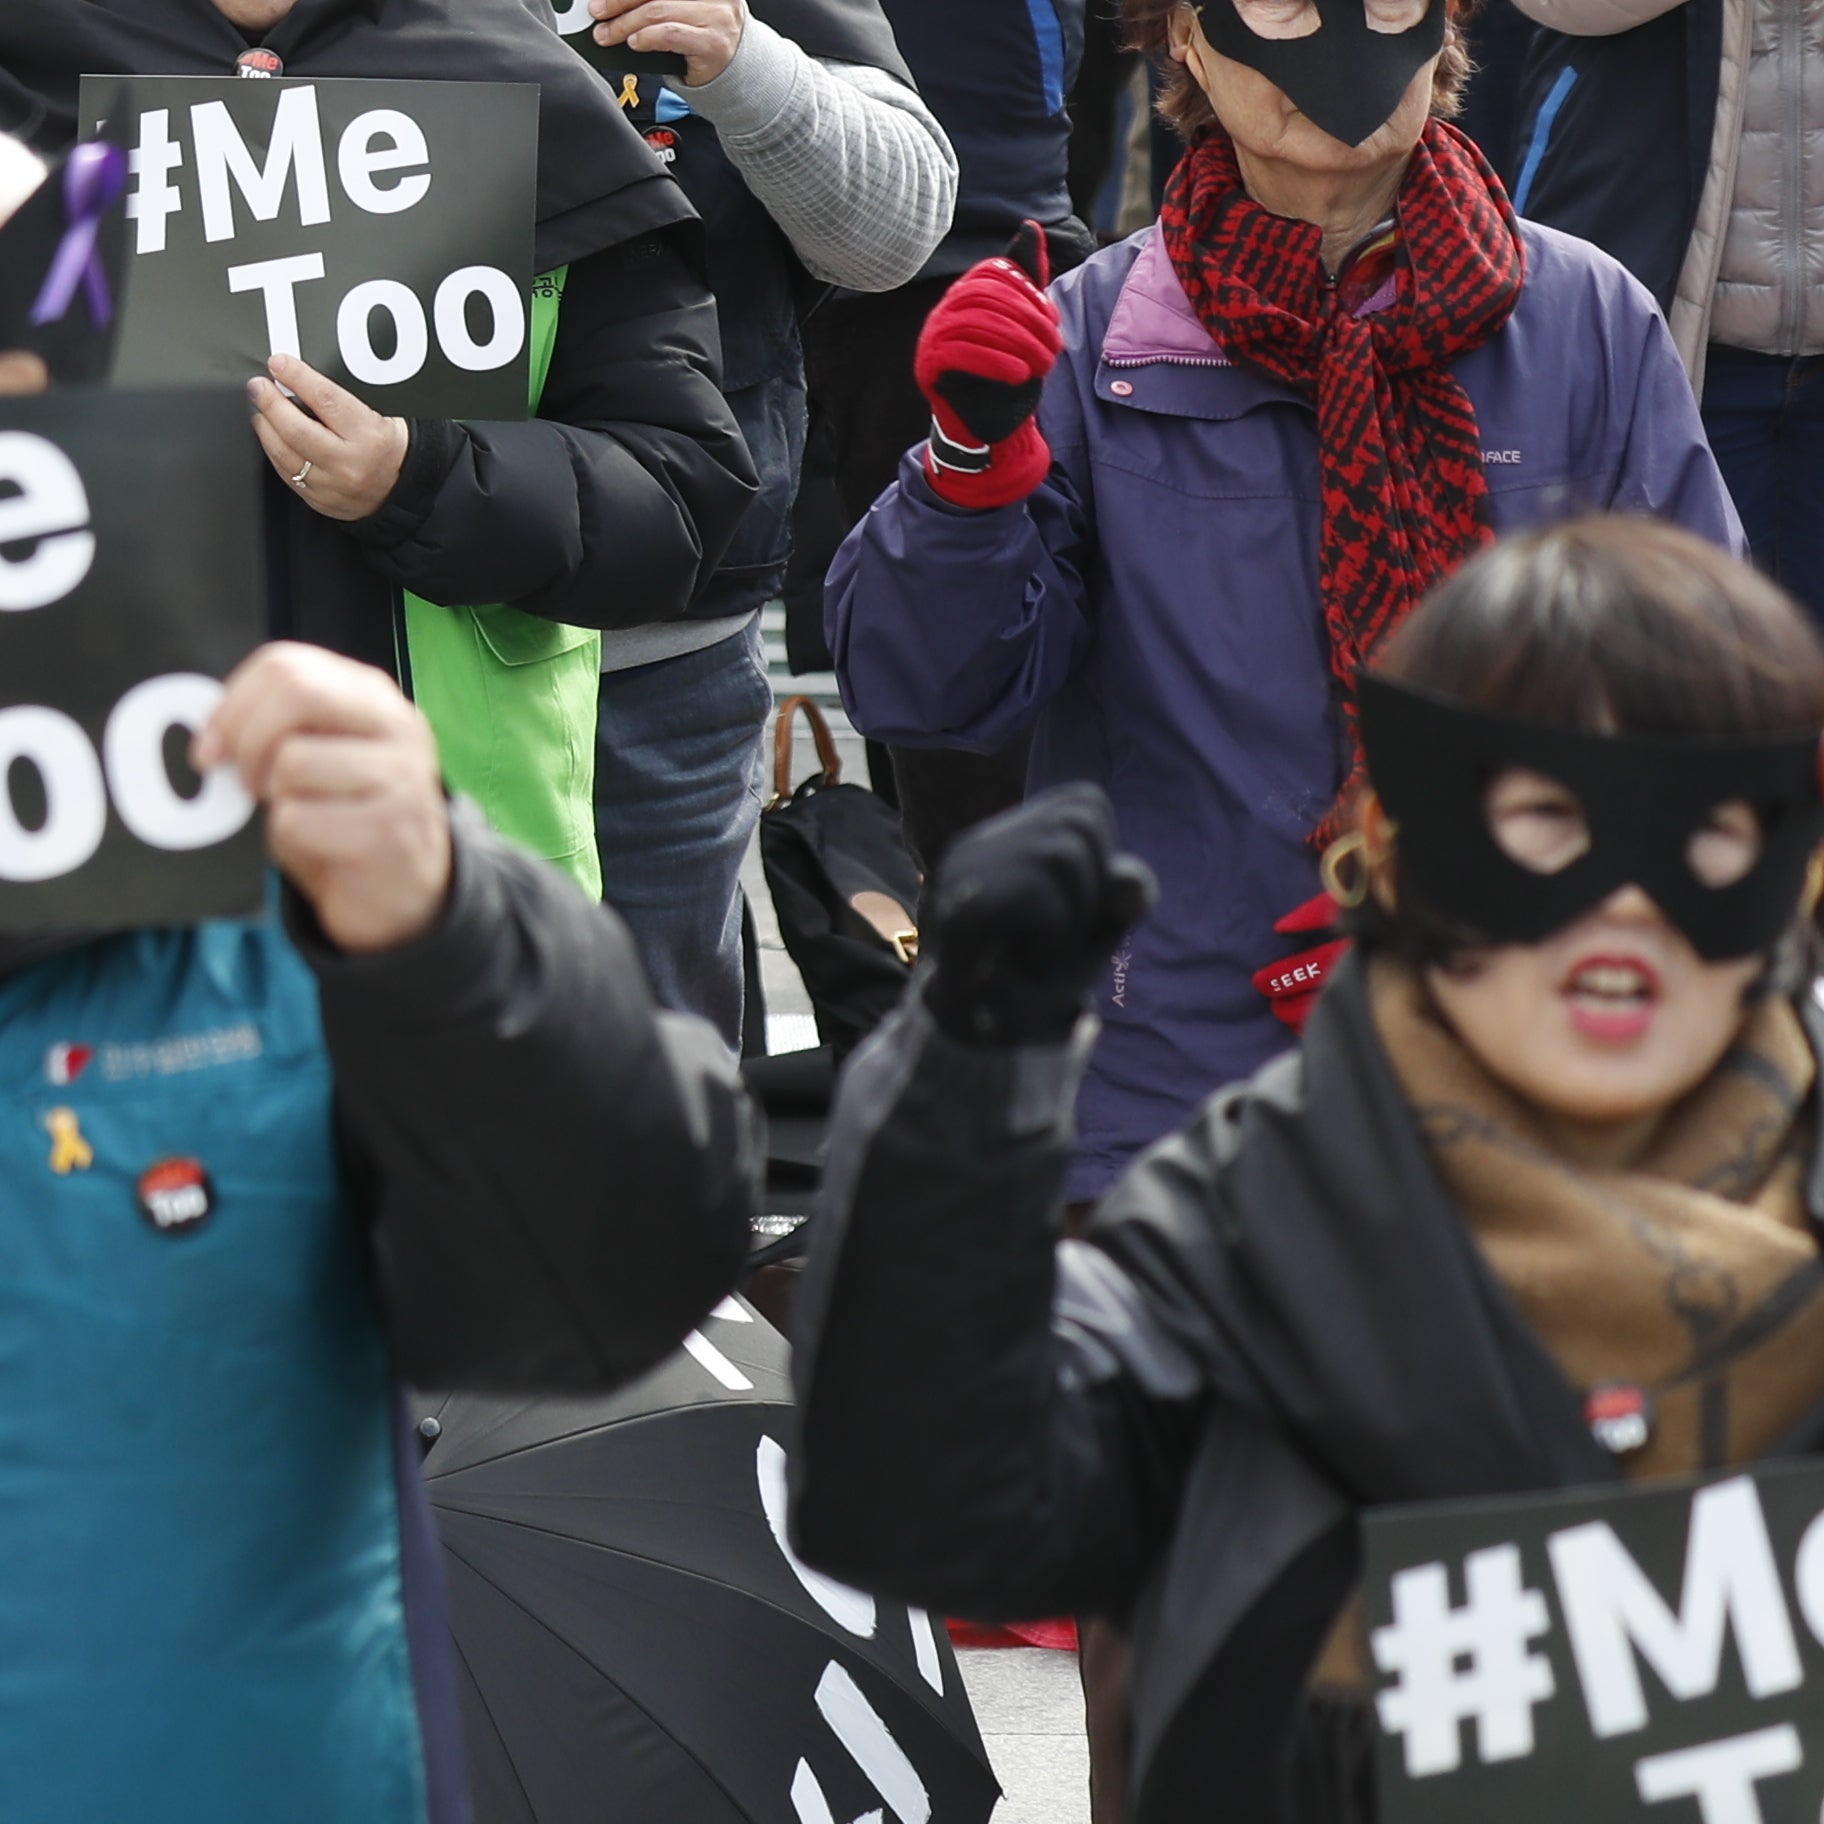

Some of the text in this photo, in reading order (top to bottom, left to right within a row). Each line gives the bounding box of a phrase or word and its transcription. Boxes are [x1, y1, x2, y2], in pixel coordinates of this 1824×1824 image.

[126, 82, 433, 255] #Me
[227, 253, 527, 396] Too
[1373, 1473, 1824, 1776] #M
